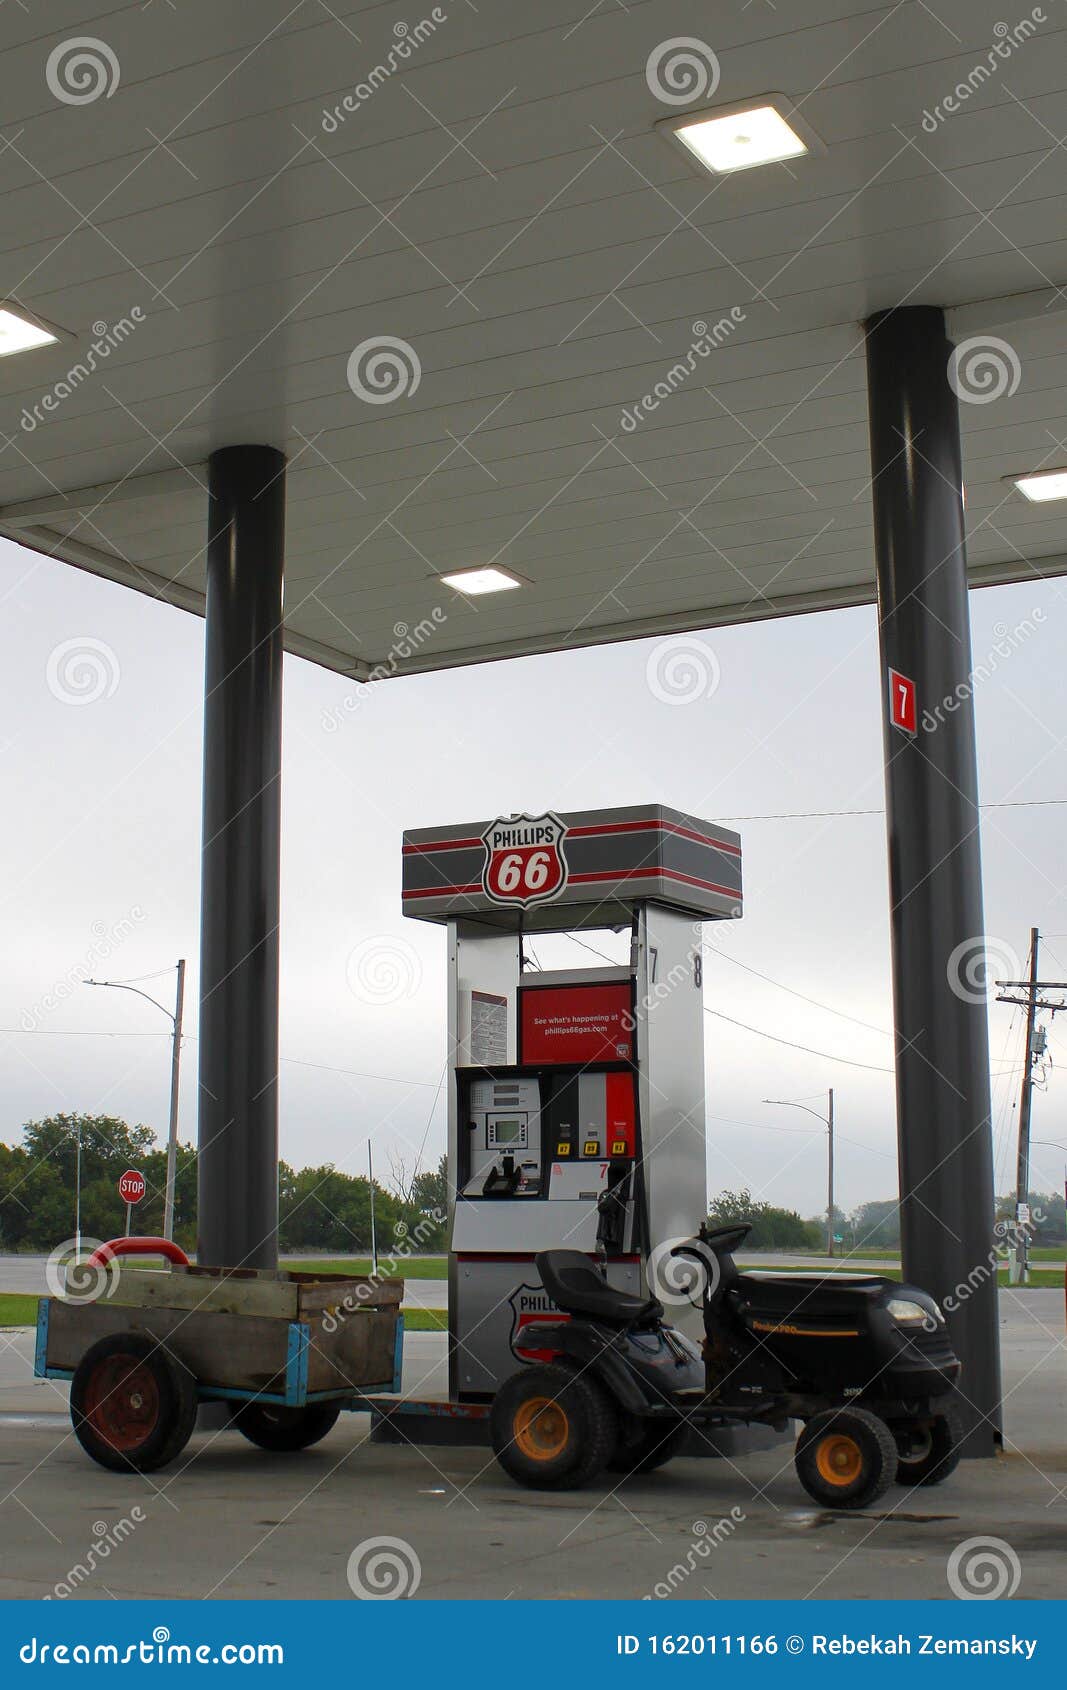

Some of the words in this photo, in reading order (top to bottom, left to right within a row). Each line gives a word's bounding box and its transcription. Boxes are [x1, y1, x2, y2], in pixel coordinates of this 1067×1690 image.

[899, 684, 907, 719] 7
[493, 826, 554, 848] PHILLIPS
[497, 852, 551, 892] 66
[650, 947, 657, 983] 7
[694, 955, 702, 988] 8
[548, 1016, 571, 1024] what's
[572, 1014, 609, 1023] happening
[544, 1026, 608, 1036] phillips66gas.com
[600, 1163, 608, 1179] 7
[121, 1180, 144, 1193] STOP
[520, 1296, 558, 1311] PHILL
